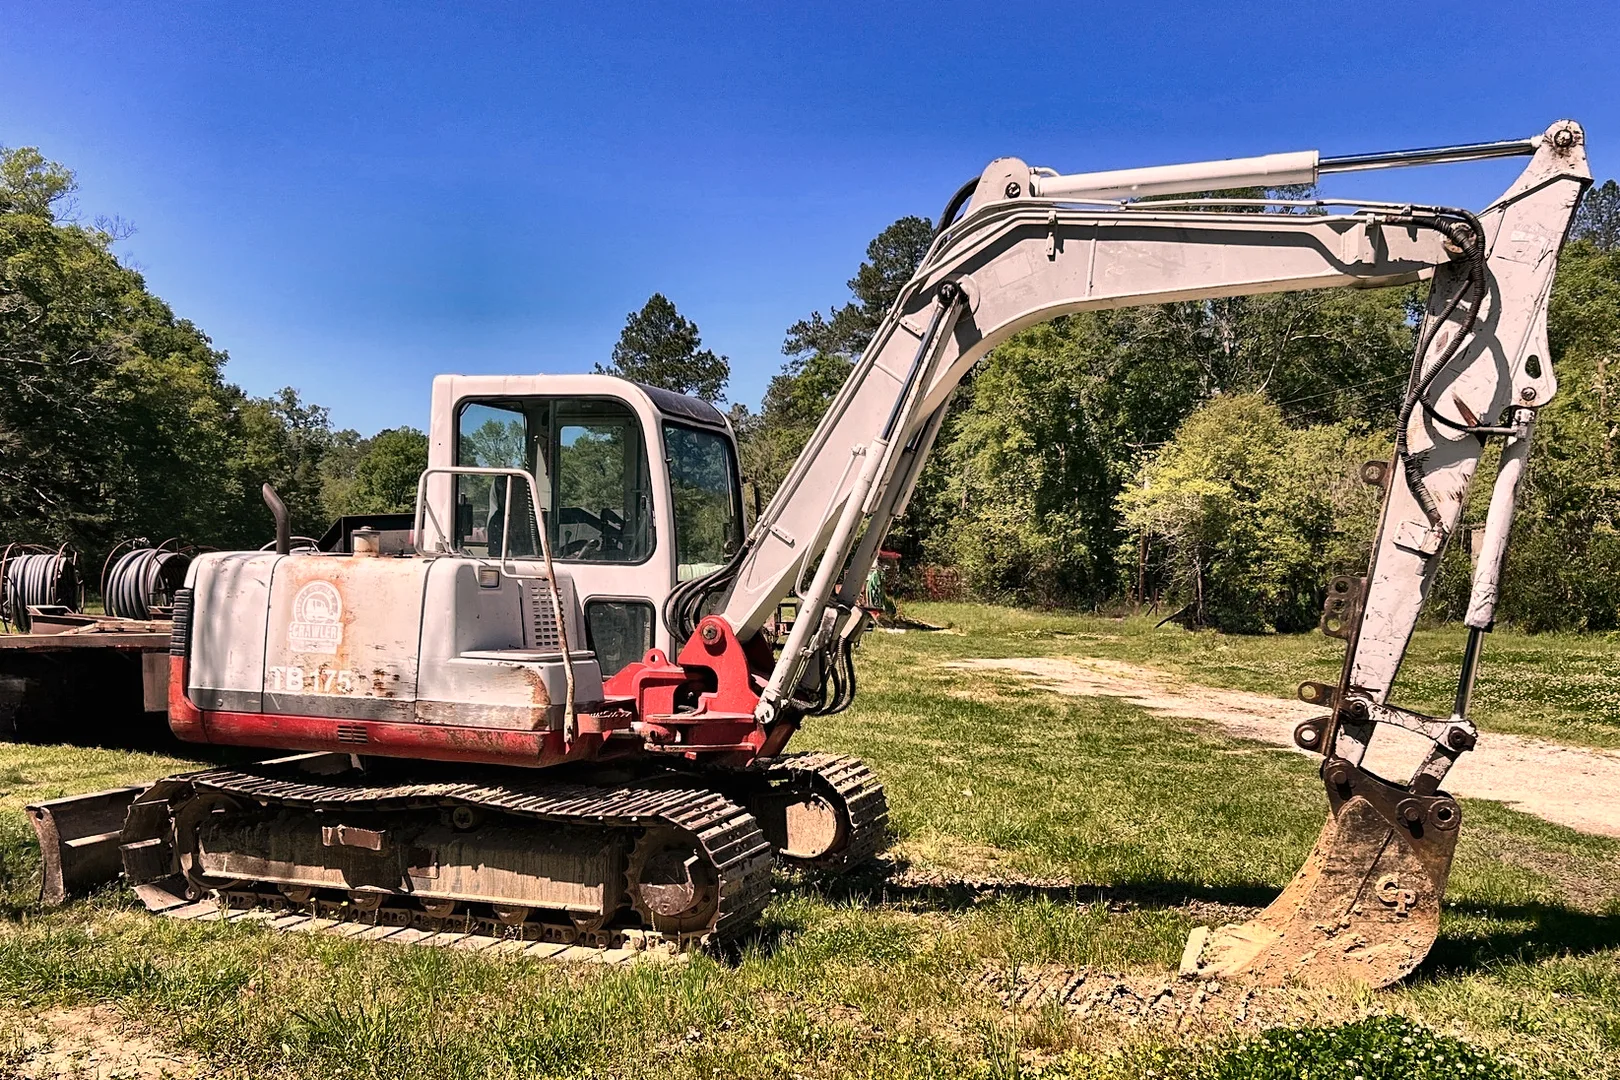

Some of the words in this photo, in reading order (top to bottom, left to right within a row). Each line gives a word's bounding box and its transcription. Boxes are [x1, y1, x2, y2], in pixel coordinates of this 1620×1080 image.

[292, 624, 337, 639] CRAWLER
[269, 666, 303, 691] TB
[311, 669, 352, 694] 175
